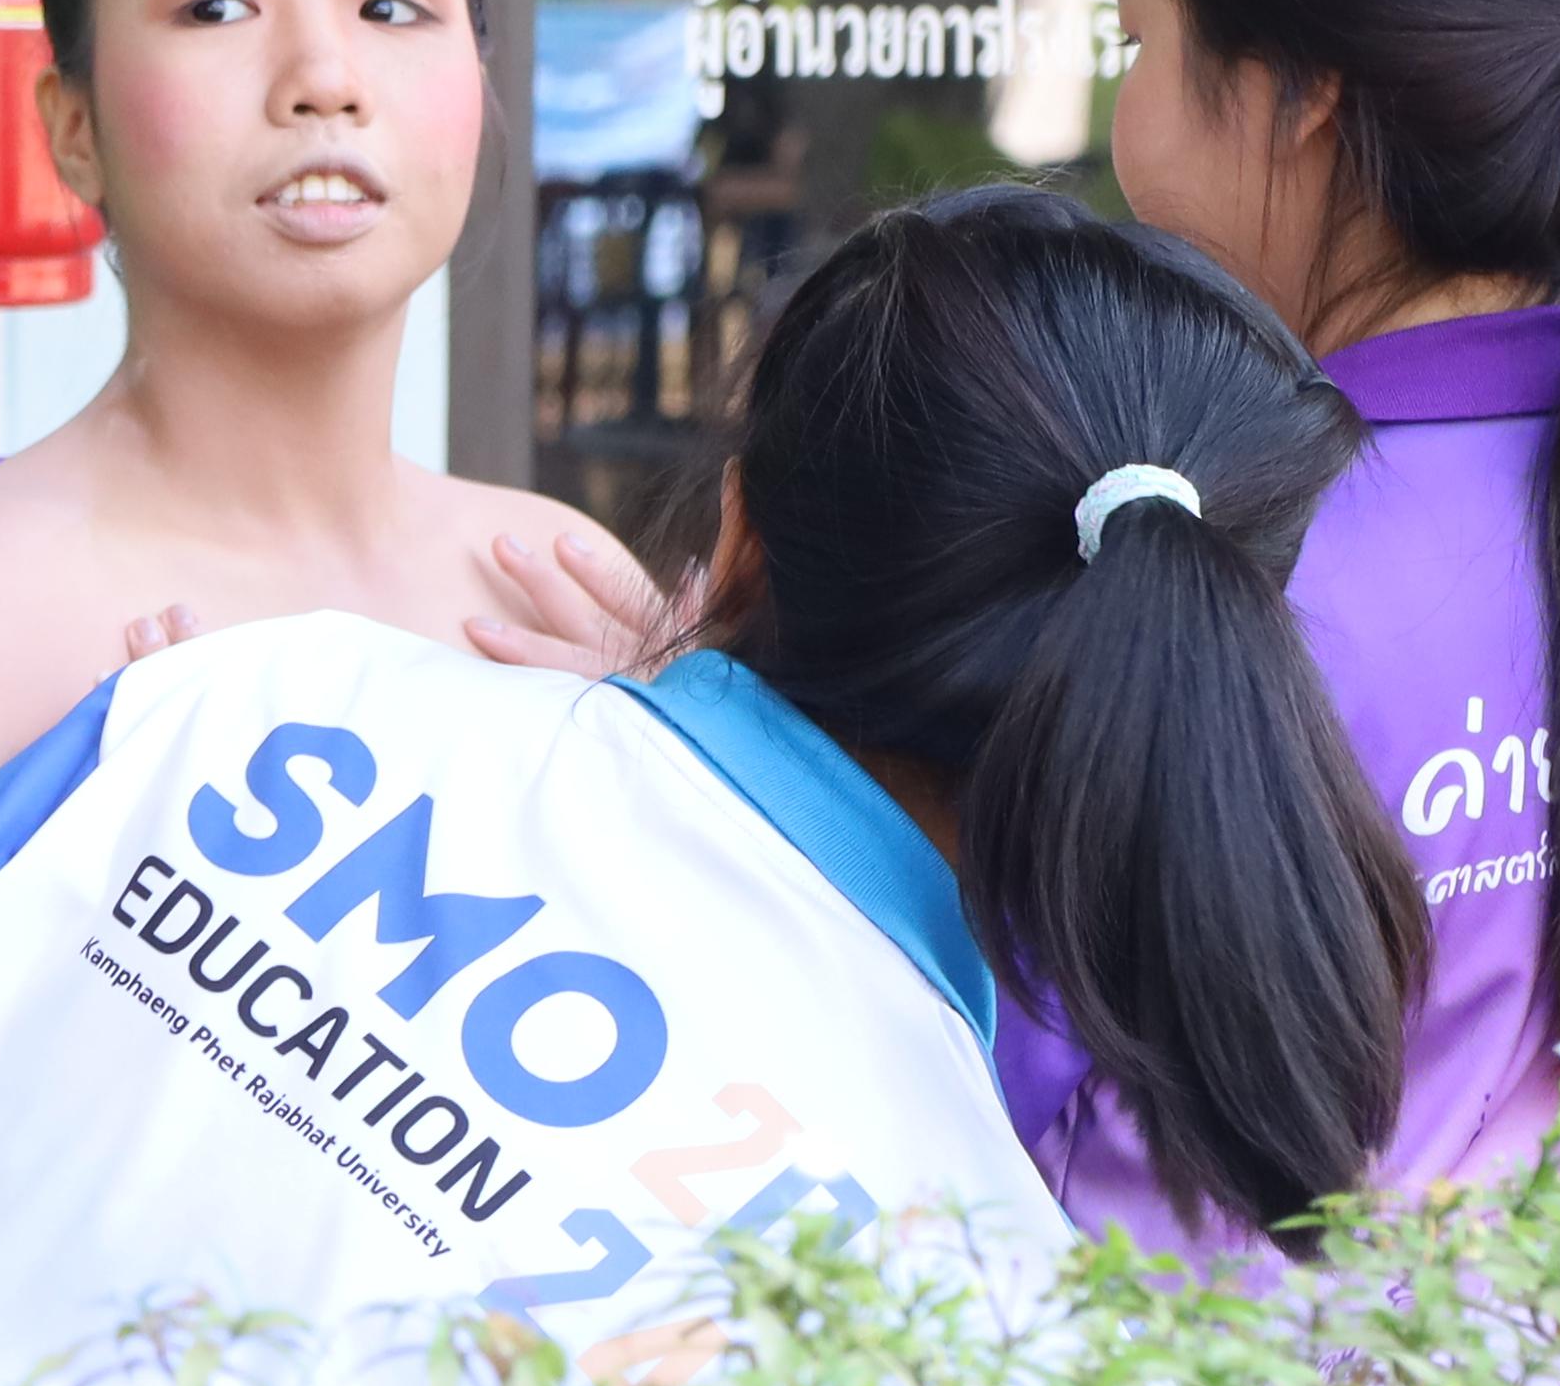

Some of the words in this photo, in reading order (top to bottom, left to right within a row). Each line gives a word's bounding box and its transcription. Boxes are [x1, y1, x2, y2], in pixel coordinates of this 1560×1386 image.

[80, 934, 190, 1036] Kamphaeng
[189, 1024, 250, 1082] Phet
[244, 1072, 338, 1155] Rajabhat
[336, 1142, 452, 1260] University
[112, 853, 533, 1223] EDUCATION
[186, 721, 668, 1129] SMO
